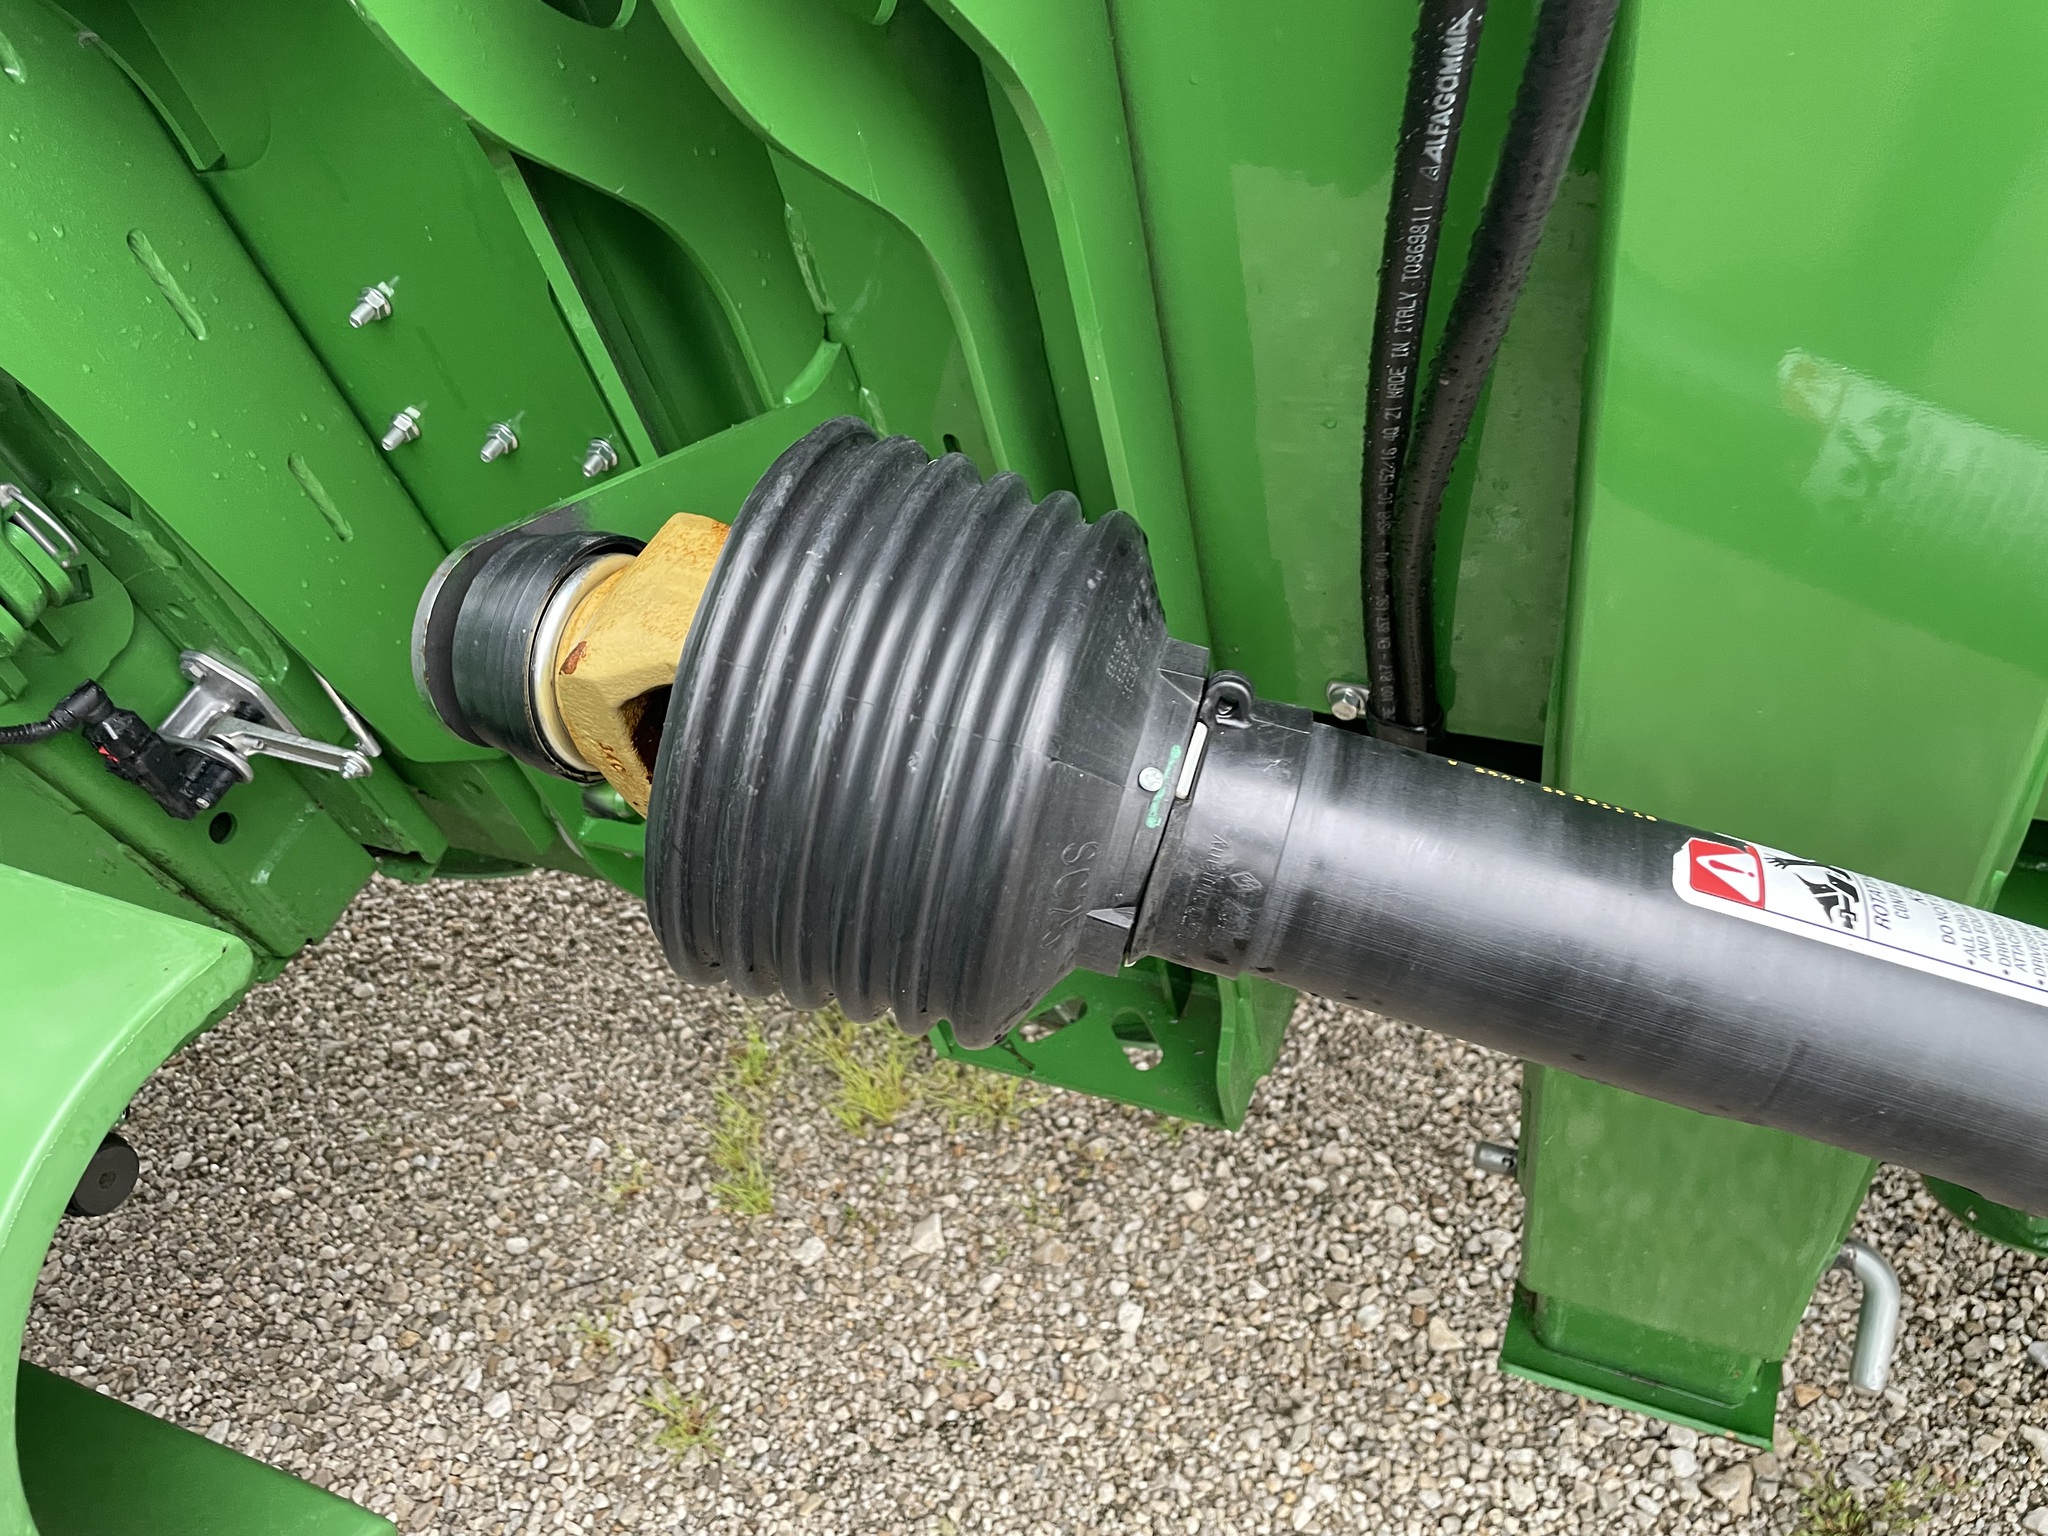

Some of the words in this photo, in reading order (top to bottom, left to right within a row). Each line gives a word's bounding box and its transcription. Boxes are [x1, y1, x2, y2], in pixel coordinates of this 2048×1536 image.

[1422, 8, 1474, 164] ALFAGOMMA
[1394, 292, 1418, 334] ITALY
[1391, 341, 1411, 358] IN
[1386, 365, 1408, 399] MADE
[1939, 924, 1956, 945] DO
[1961, 936, 1978, 958] ALL
[1976, 935, 1993, 962] AND
